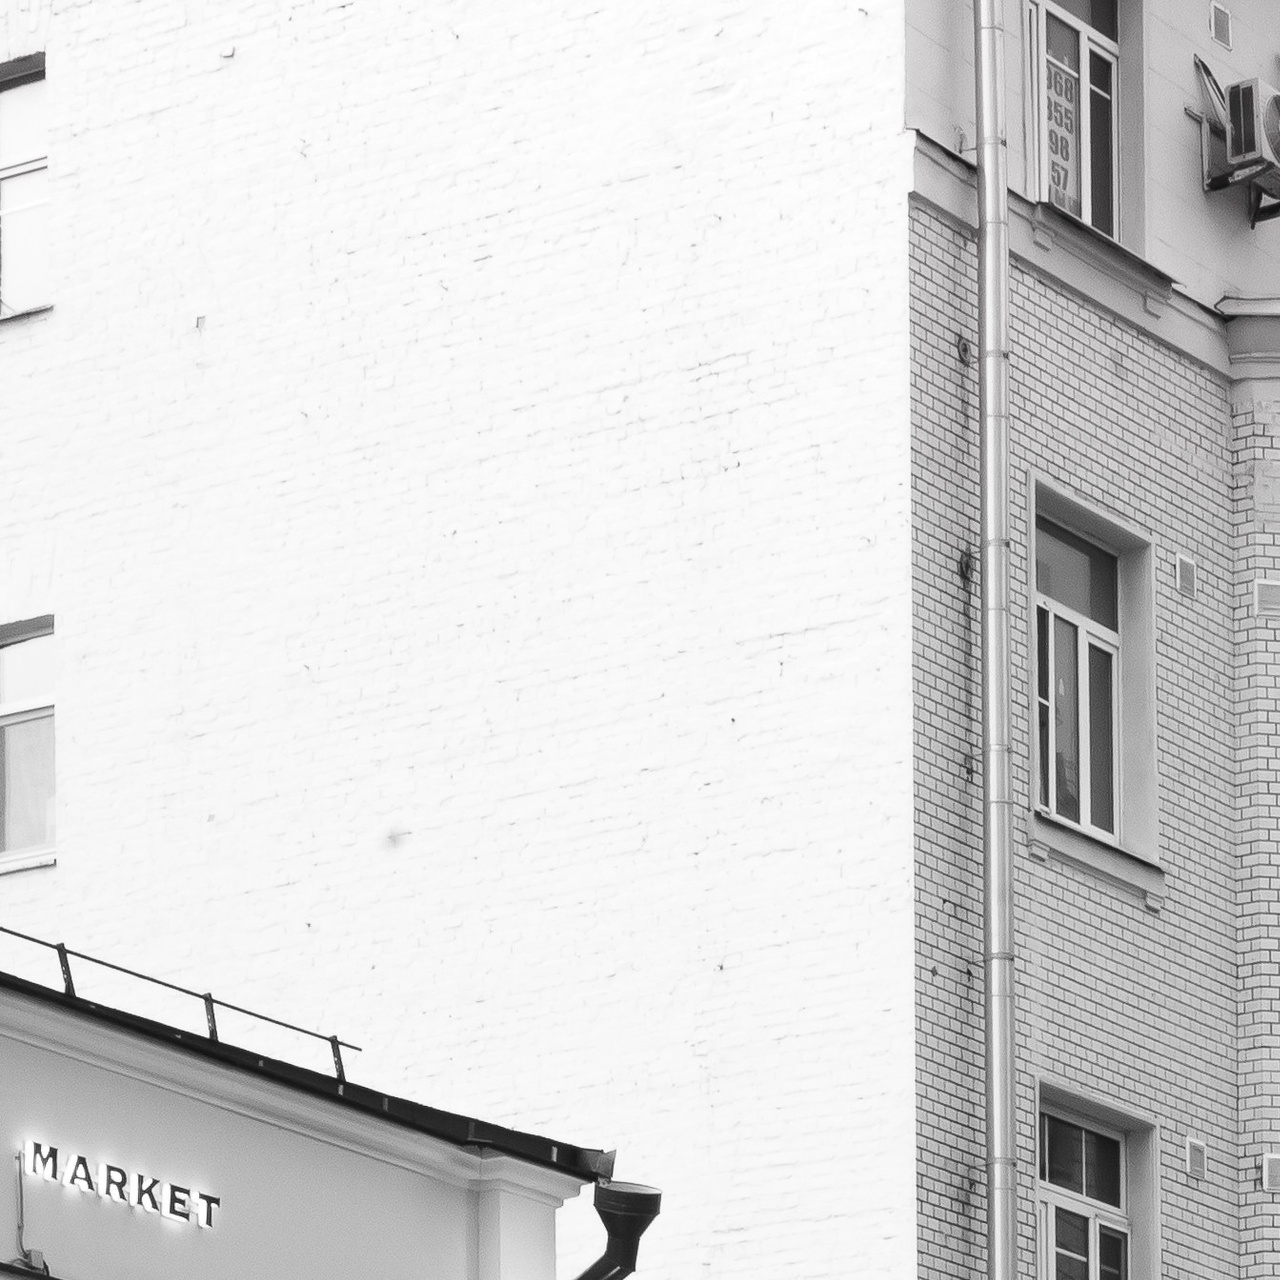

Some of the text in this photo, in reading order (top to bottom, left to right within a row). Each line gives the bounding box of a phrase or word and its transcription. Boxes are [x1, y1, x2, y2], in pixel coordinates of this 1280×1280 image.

[1049, 129, 1069, 161] 98
[1051, 160, 1068, 191] 57
[25, 1140, 220, 1228] MARKET
